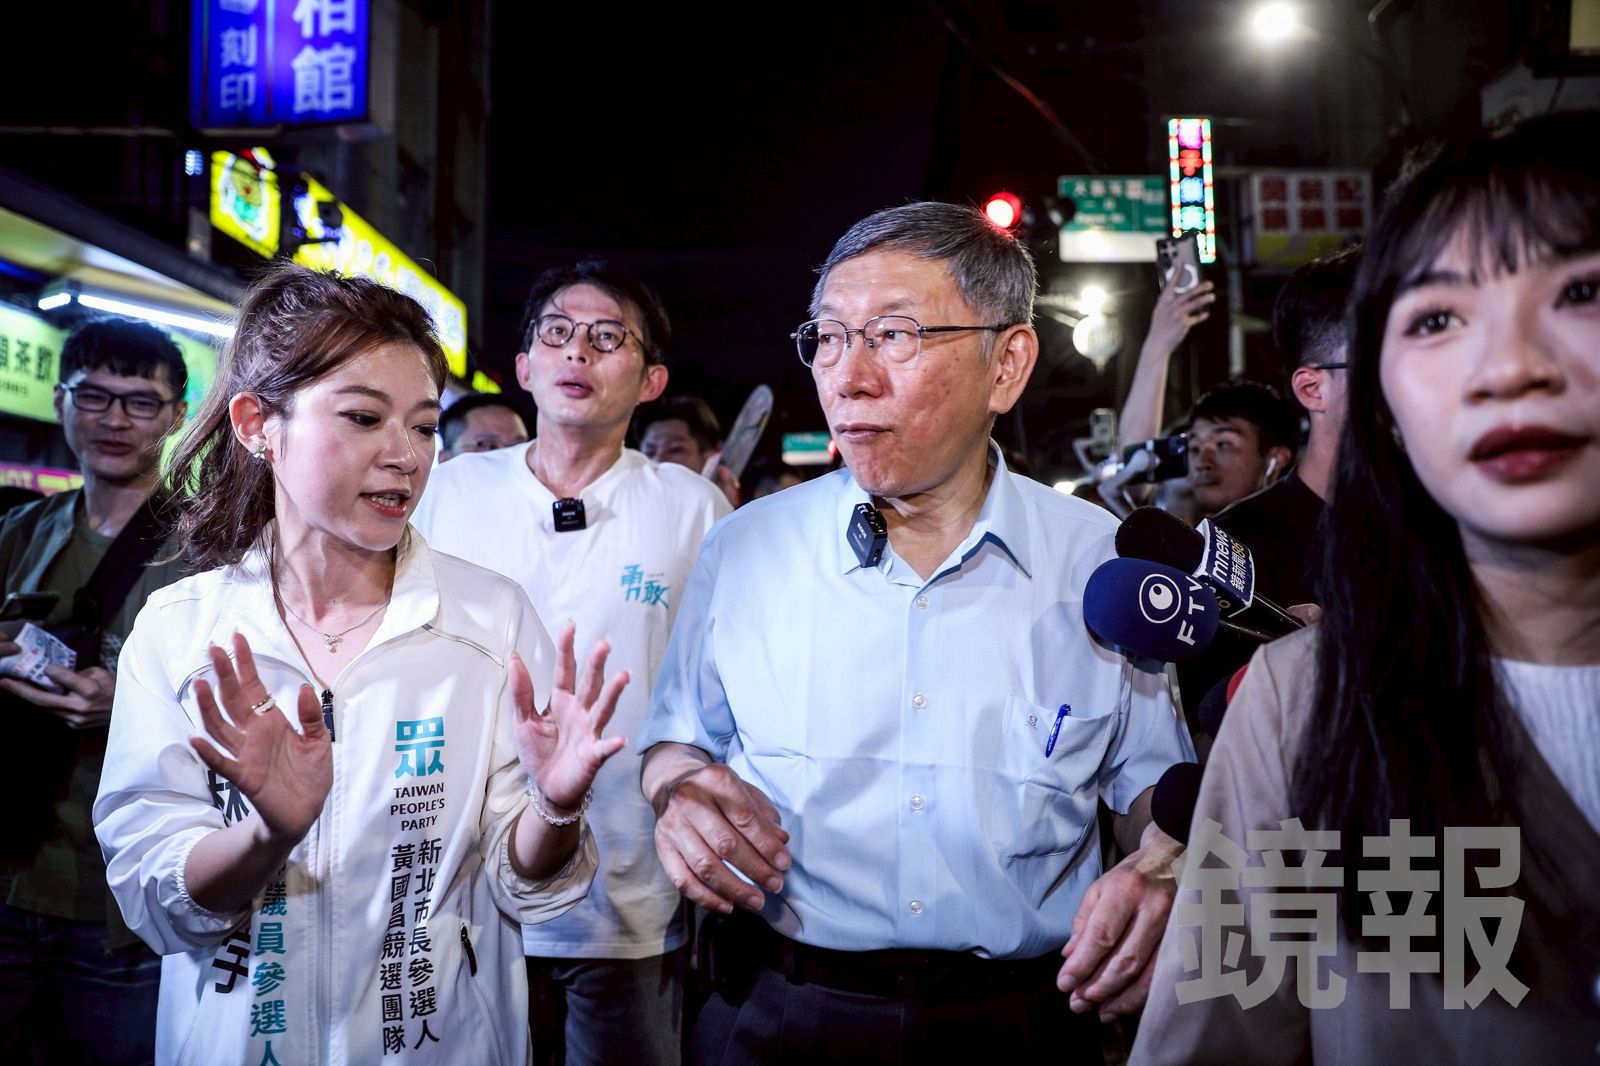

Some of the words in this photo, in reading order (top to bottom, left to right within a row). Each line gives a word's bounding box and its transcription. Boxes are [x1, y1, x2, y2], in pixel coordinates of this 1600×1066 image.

[218, 0, 258, 111] 刻印
[1212, 526, 1230, 583] mnews
[620, 564, 671, 610] 勇敢
[1176, 575, 1206, 646] FTV
[390, 798, 445, 816] PEOPLE'S
[393, 782, 445, 799] TAIWAN
[401, 815, 438, 832] PARTY
[380, 843, 416, 1056] 黃國昌競選團隊
[407, 837, 442, 1051] 新北市長參選人
